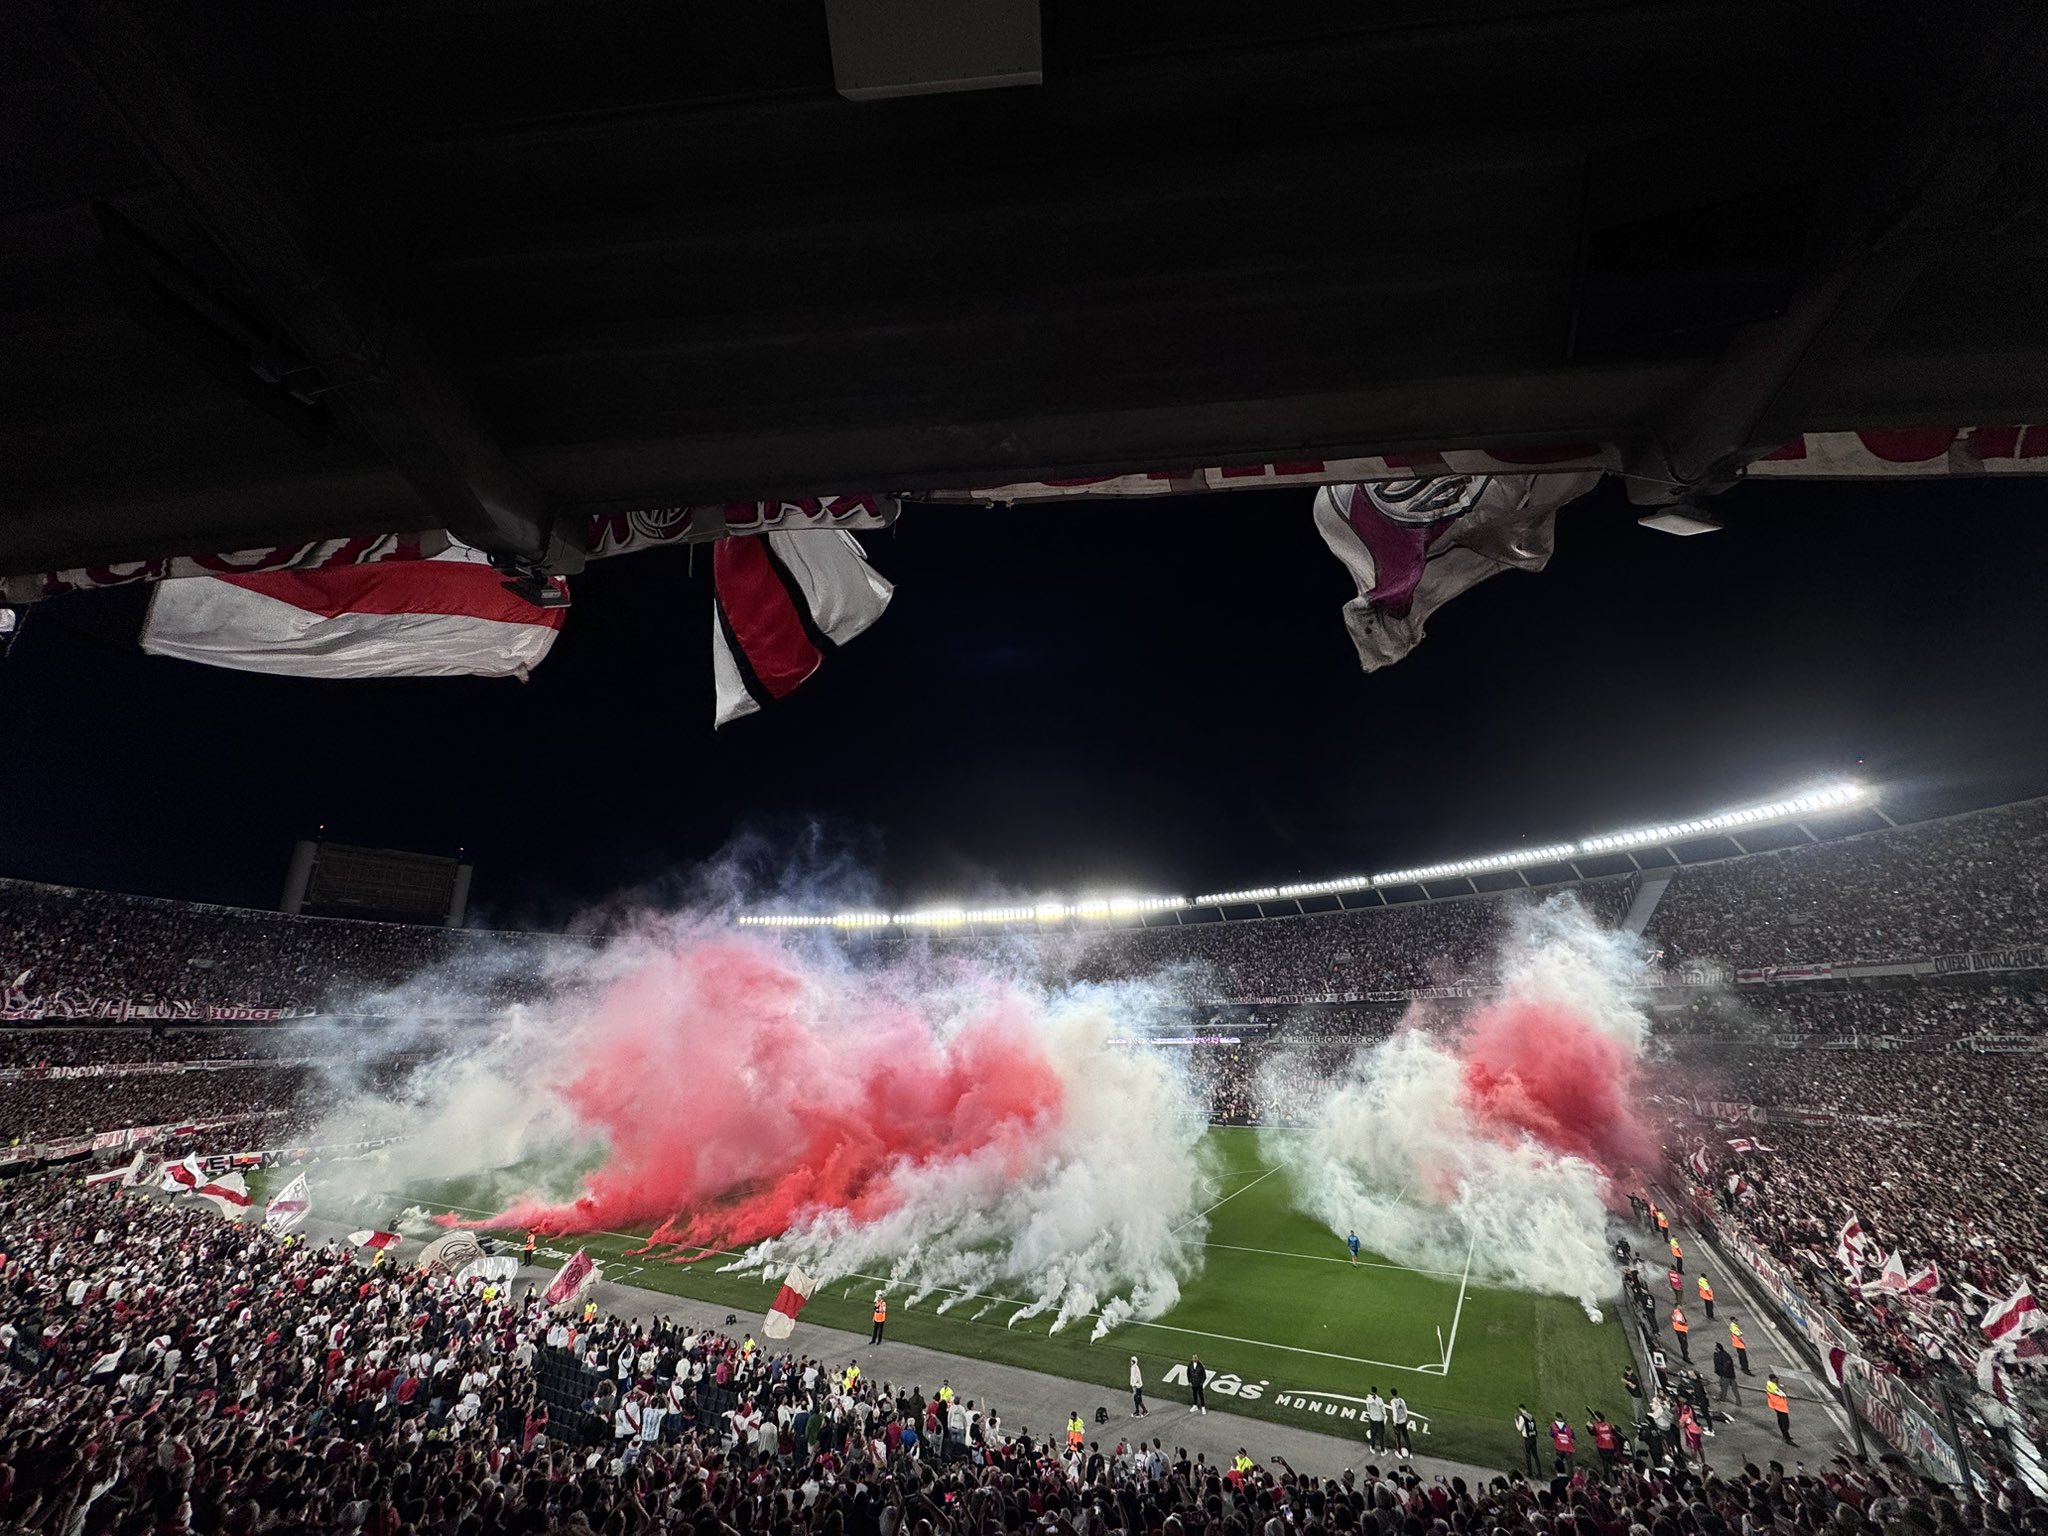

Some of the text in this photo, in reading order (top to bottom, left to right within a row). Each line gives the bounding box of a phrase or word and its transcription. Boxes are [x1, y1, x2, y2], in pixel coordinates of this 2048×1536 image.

[211, 1007, 281, 1020] BUDGE
[50, 1064, 105, 1079] RINCON
[1275, 1394, 1431, 1435] MONUMEAL
